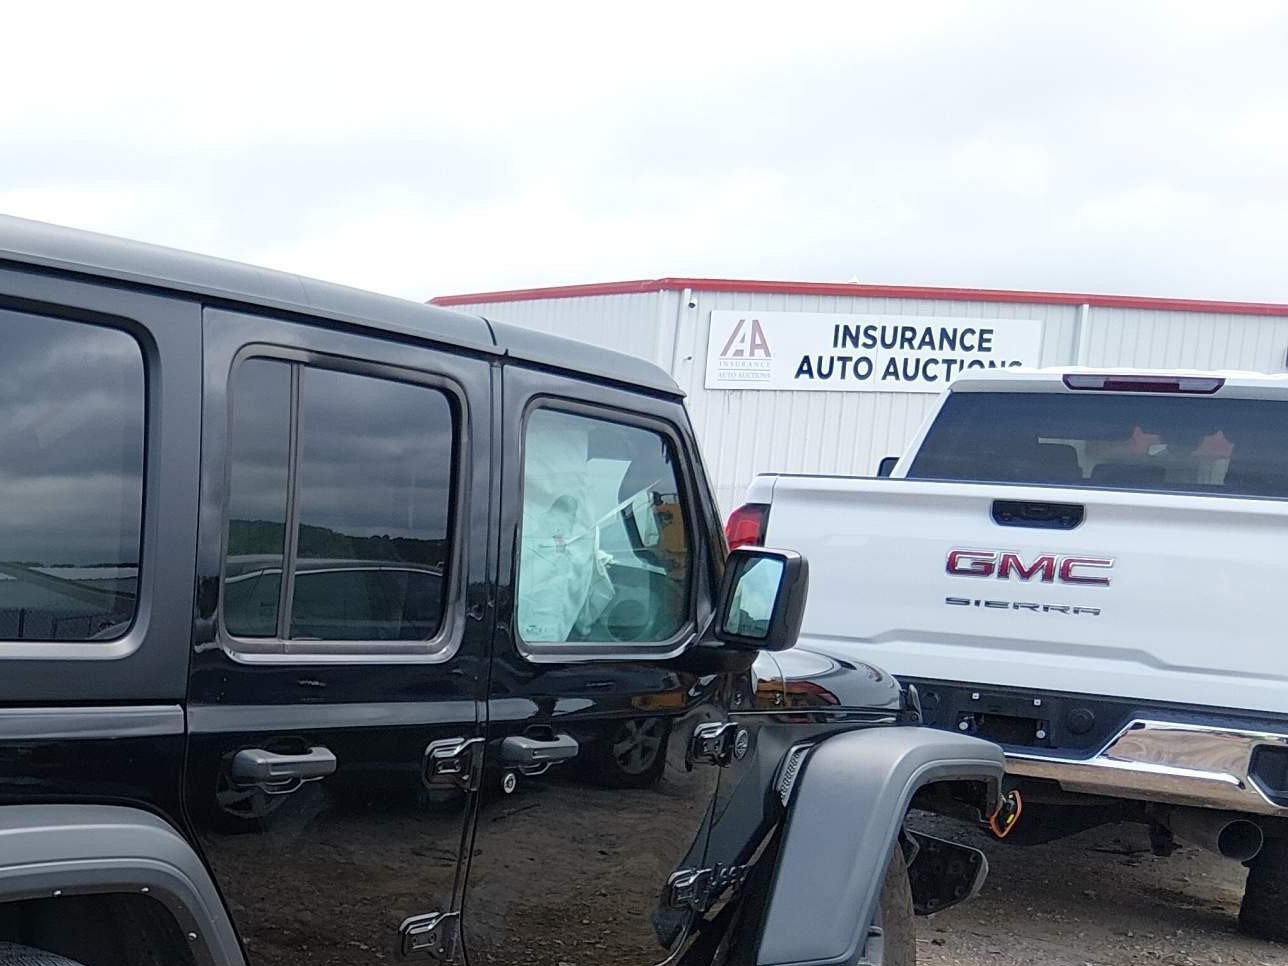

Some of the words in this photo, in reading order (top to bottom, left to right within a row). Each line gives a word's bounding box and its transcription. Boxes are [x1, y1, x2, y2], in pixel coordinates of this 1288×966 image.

[832, 324, 994, 352] INSURANCE
[794, 355, 873, 380] AUTO
[945, 549, 1114, 586] GMC
[945, 597, 1102, 616] SIERRA
